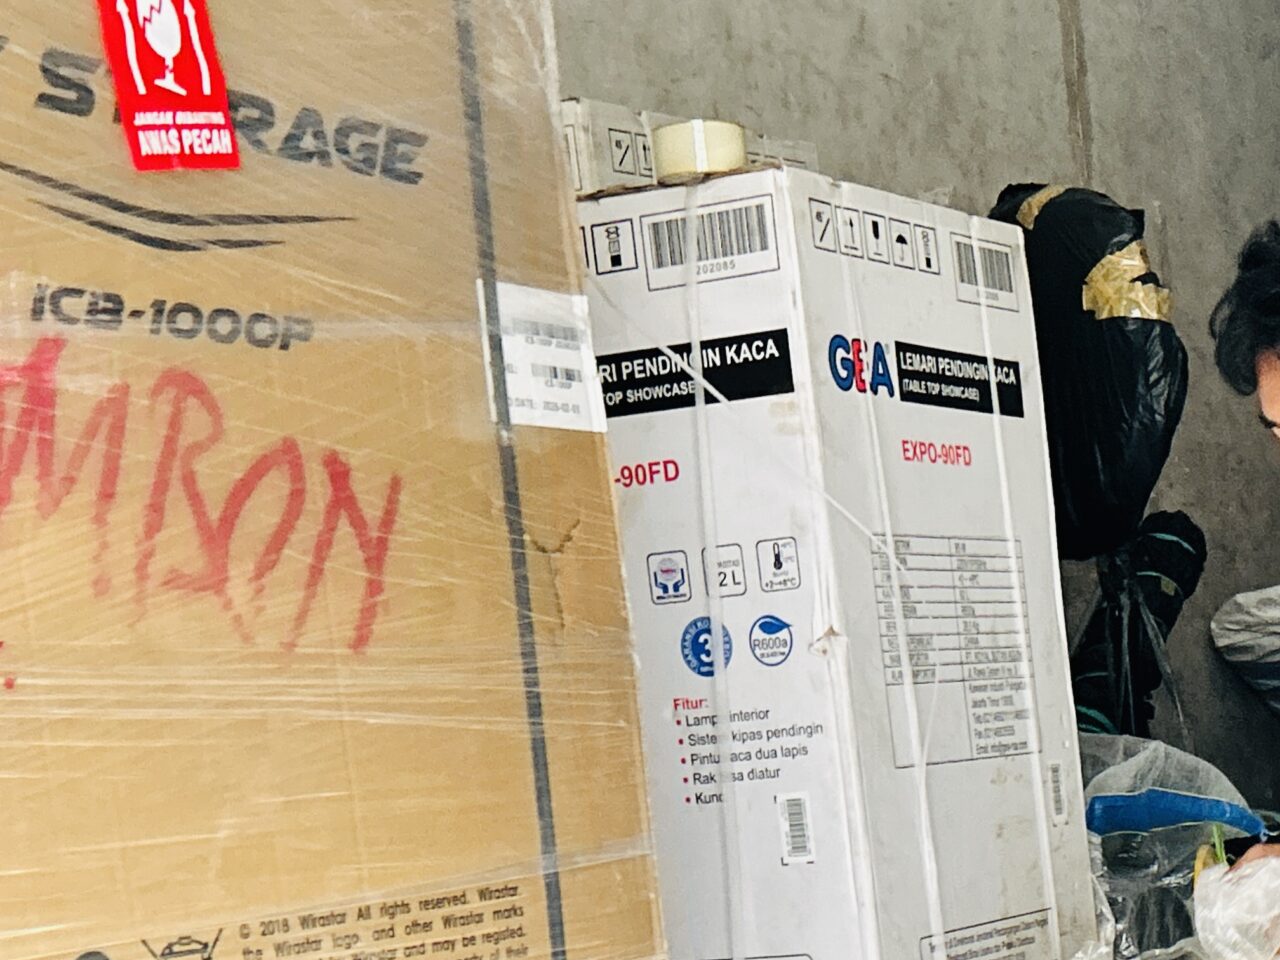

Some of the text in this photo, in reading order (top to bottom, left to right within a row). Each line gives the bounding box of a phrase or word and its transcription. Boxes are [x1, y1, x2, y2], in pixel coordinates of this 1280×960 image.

[34, 46, 430, 186] SRAGE
[137, 128, 233, 156] AWAS PECAH
[30, 283, 315, 350] ICB-1000P
[725, 339, 780, 366] KACA
[828, 334, 895, 398] GEA
[900, 351, 937, 374] LEMARI
[994, 365, 1017, 387] ACA
[901, 439, 972, 467] EXPO-90FD
[614, 459, 680, 488] -90FD
[752, 637, 788, 652] R600a
[673, 698, 709, 711] Fitur:
[686, 709, 770, 727] Lamp interior
[688, 723, 823, 746] Siste kipas pendingin
[691, 744, 809, 766] Pintu aca dua lapis
[693, 767, 781, 785] Rak sa diatur
[260, 918, 290, 937] 2018
[298, 911, 347, 930] Wirastar
[356, 904, 371, 921] All
[380, 900, 411, 920] rights
[273, 937, 323, 958] Wirastar
[372, 924, 395, 941] and
[405, 920, 433, 936] other
[441, 911, 484, 929] Wirastar
[493, 903, 524, 920] marks
[404, 943, 425, 958] and
[432, 939, 456, 953] may
[462, 935, 476, 947] be
